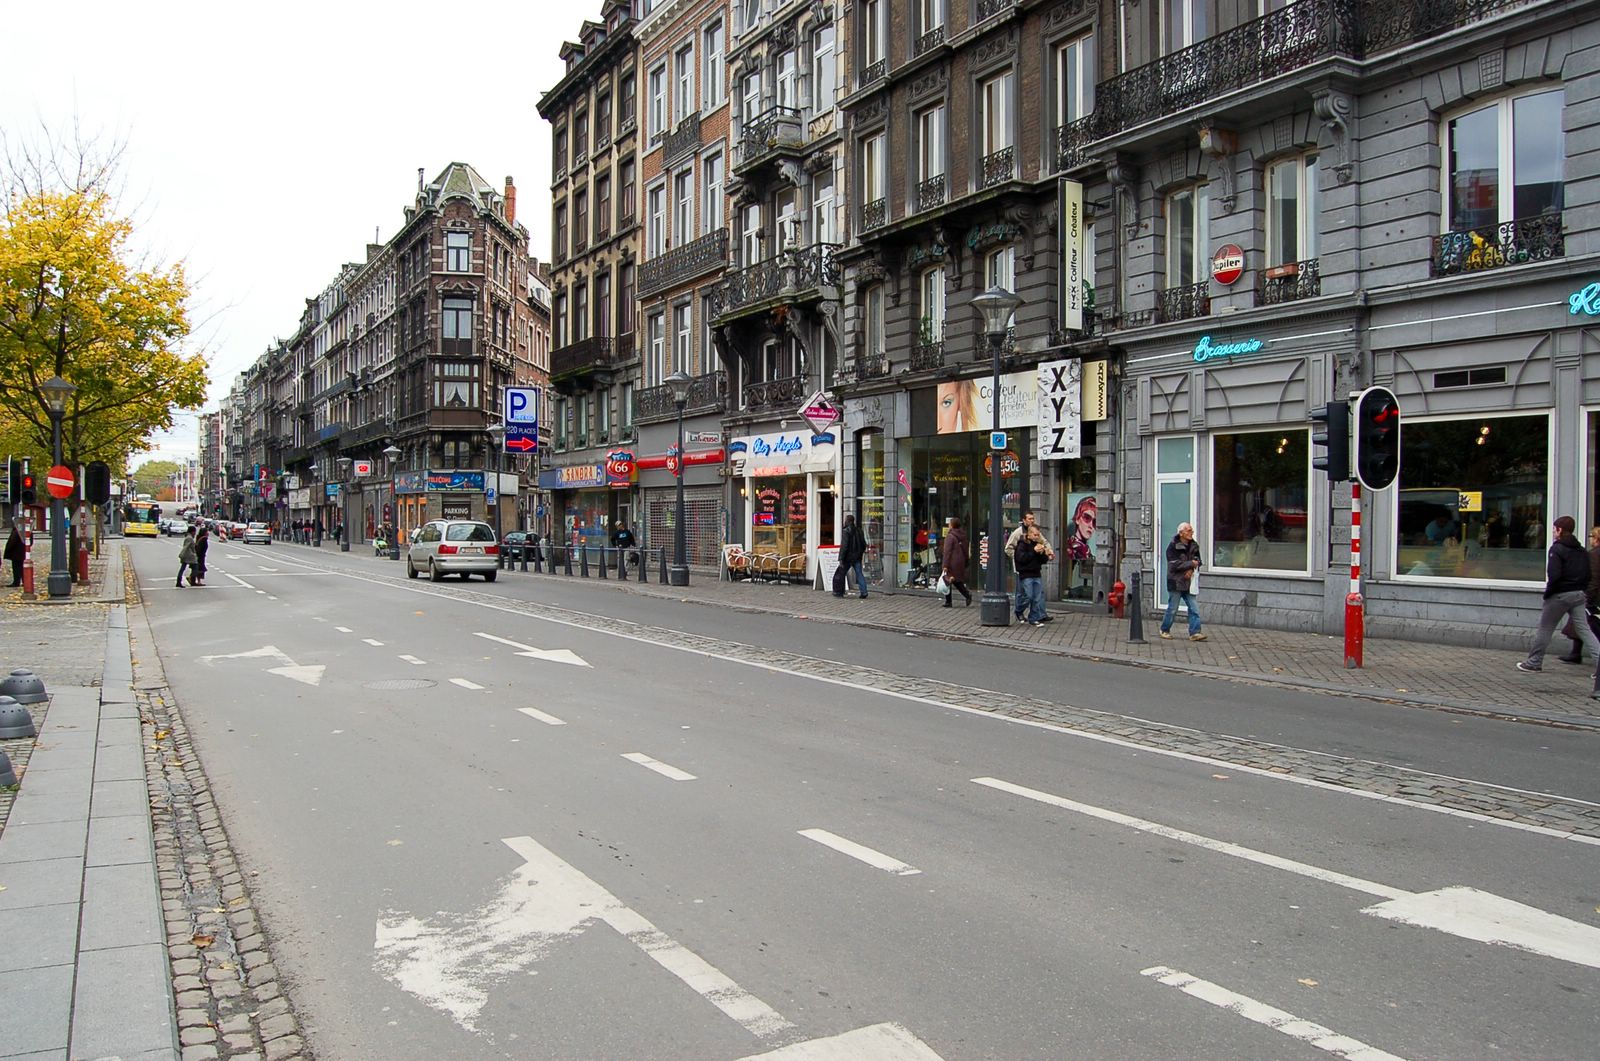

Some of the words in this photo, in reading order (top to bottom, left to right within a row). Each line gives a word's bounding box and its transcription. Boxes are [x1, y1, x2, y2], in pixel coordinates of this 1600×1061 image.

[1212, 258, 1240, 270] Jupiler
[1194, 336, 1263, 361] Brasserie
[980, 384, 1016, 399] Coeur
[510, 392, 527, 418] P
[615, 462, 628, 473] 66
[667, 458, 675, 470] 66
[566, 466, 593, 481] SANDRA
[444, 507, 469, 515] PARKING
